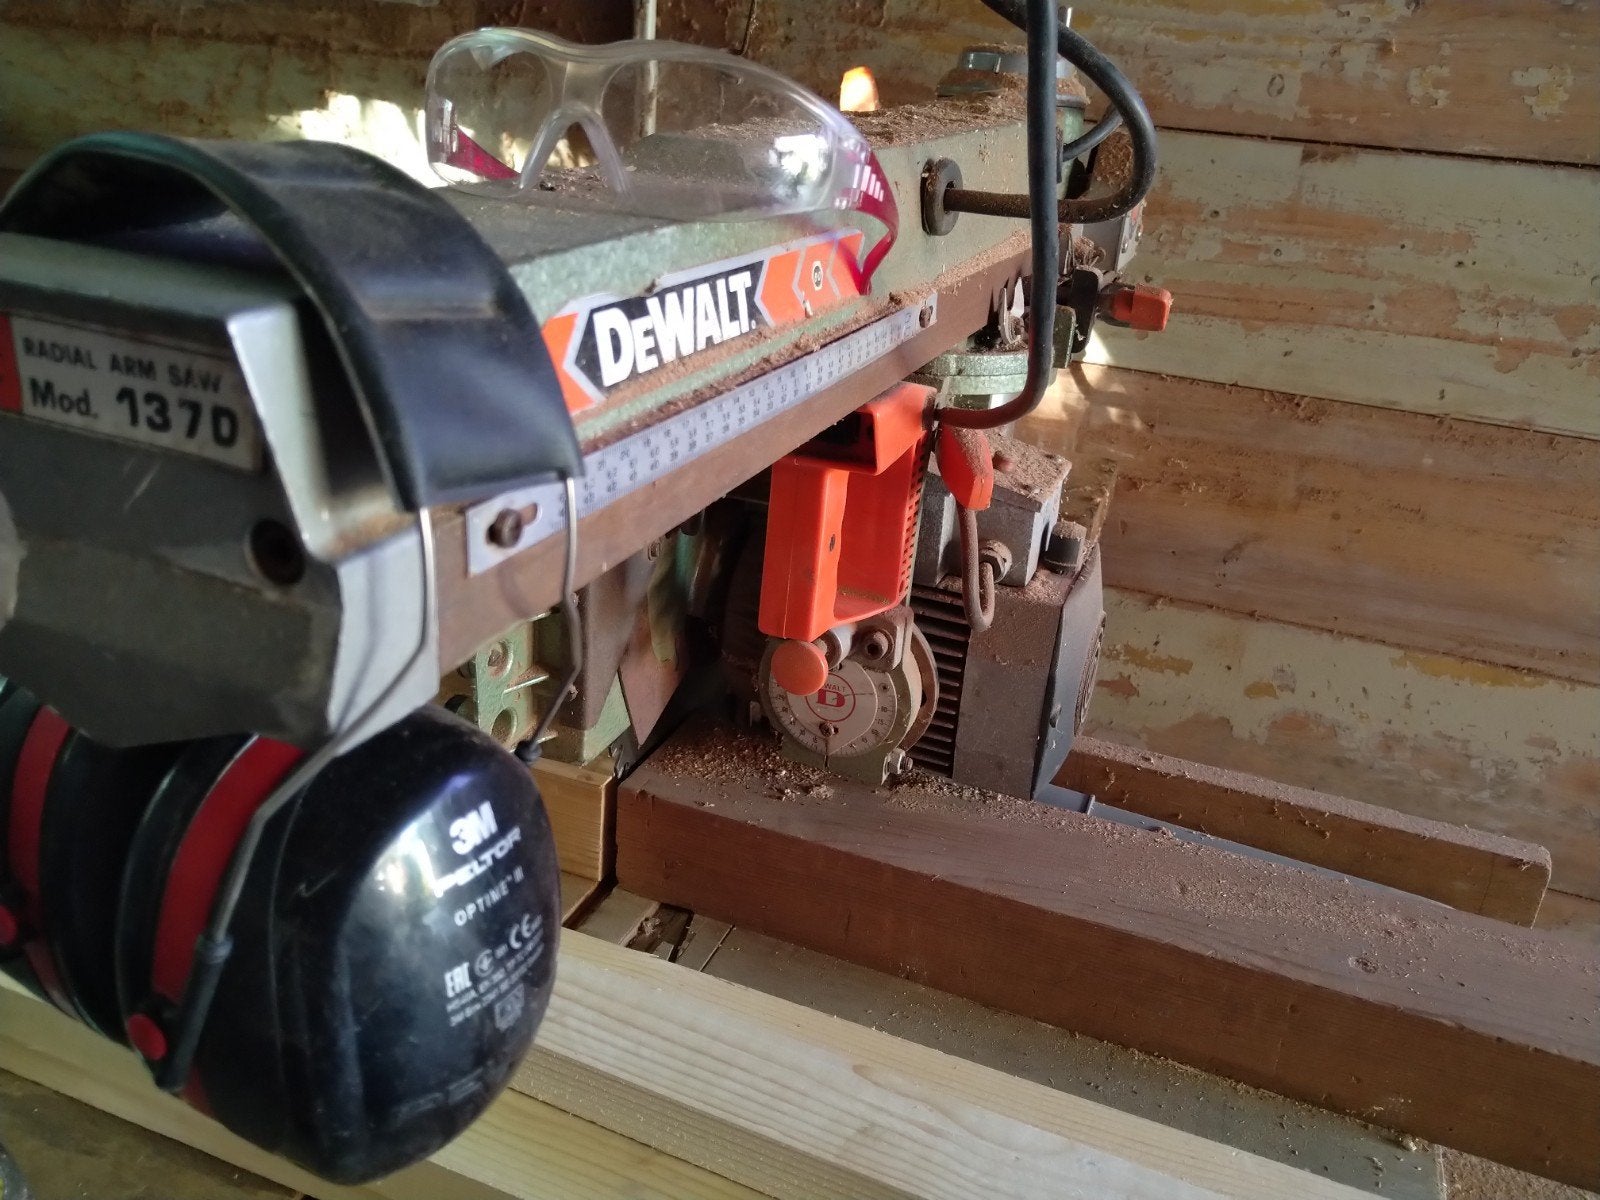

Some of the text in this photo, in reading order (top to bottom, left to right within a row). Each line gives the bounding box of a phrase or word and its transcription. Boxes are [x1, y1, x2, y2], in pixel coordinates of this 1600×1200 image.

[22, 336, 223, 394] RADIAL ARM SAW
[29, 376, 239, 447] Mod. 1370
[449, 800, 498, 855] 3M
